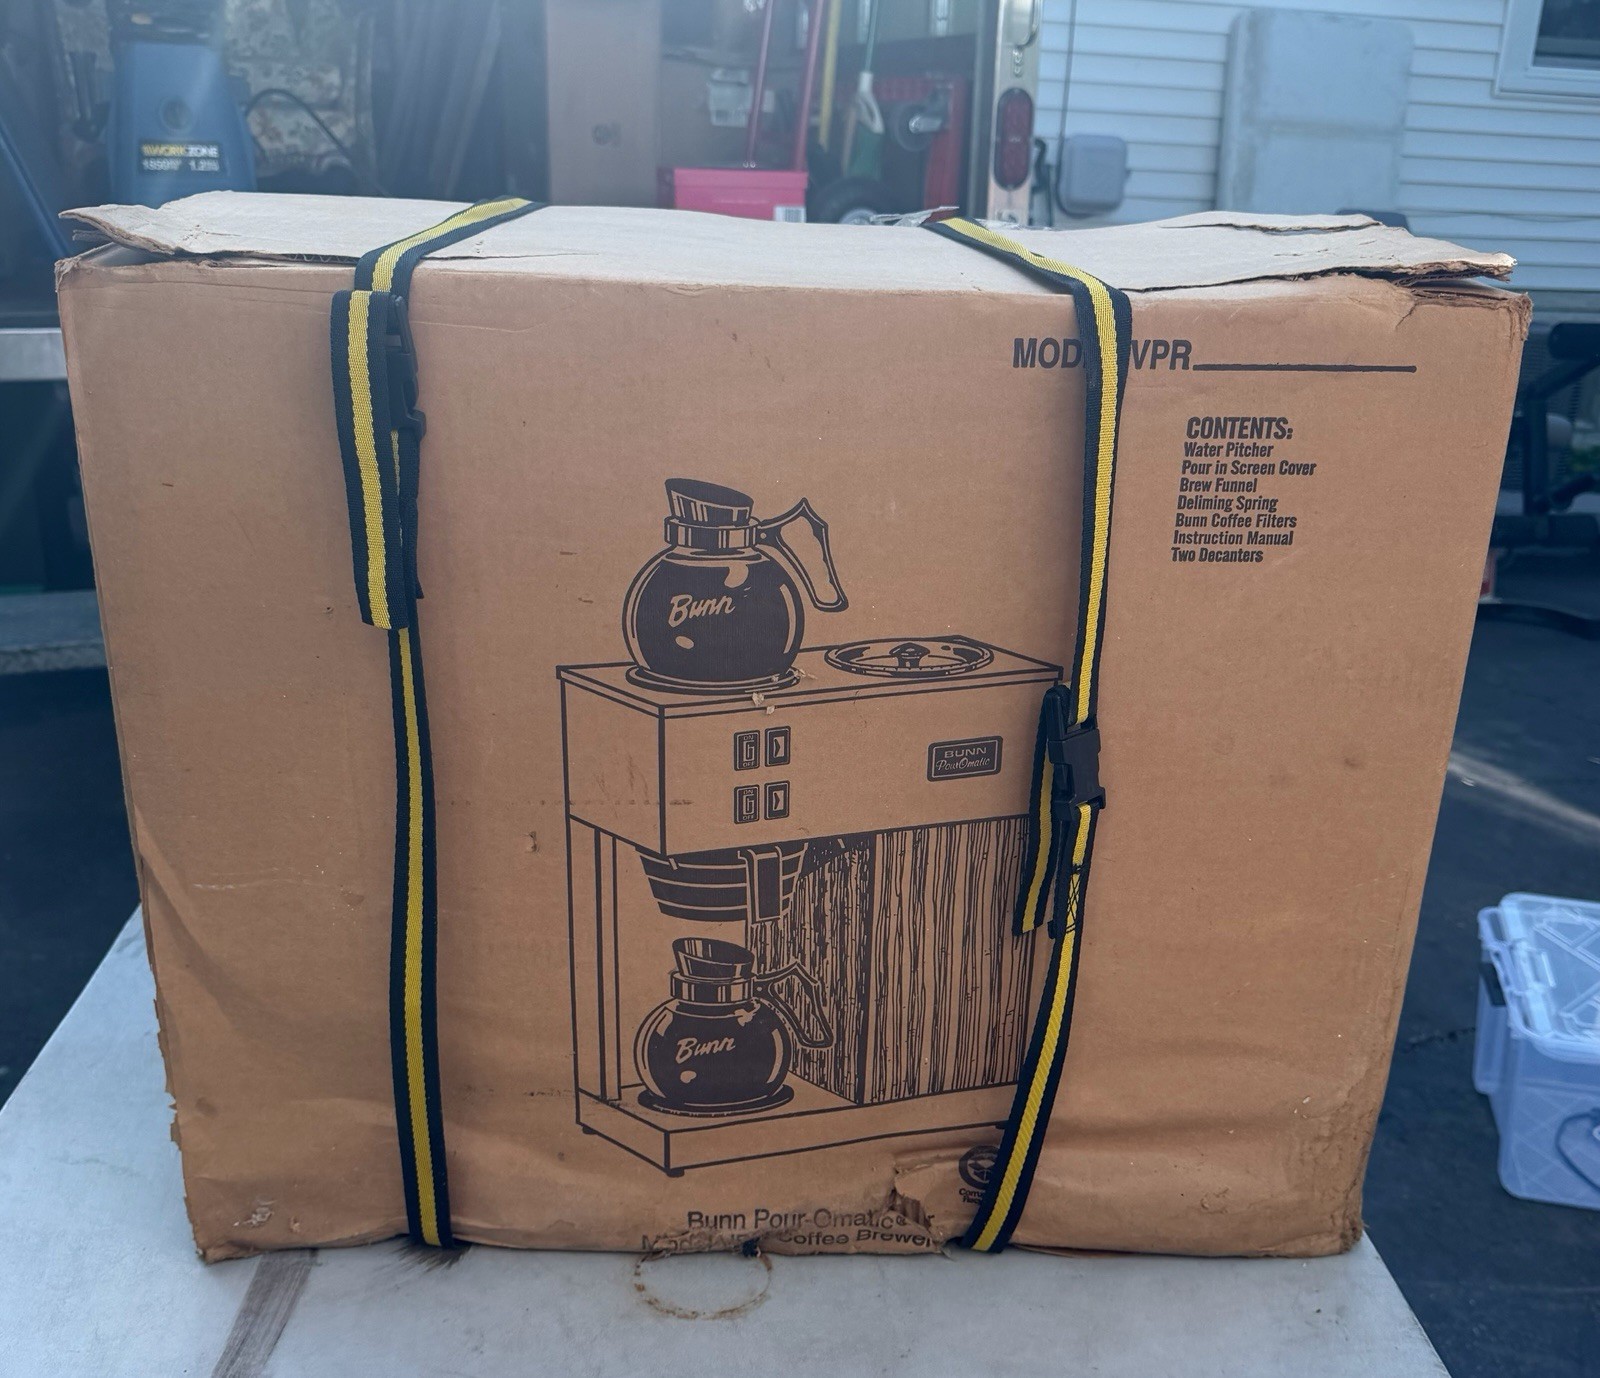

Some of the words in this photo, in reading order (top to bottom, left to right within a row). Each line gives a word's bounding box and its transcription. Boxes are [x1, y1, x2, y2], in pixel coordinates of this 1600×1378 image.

[1012, 337, 1084, 368] MOD
[1131, 339, 1192, 370] VPR
[1186, 416, 1294, 440] CONTENTS:
[1184, 442, 1223, 457] Water
[1225, 442, 1274, 457] Pitcher
[1182, 460, 1212, 475] Pour
[1215, 460, 1227, 475] in
[1231, 460, 1275, 475] Screen
[1279, 460, 1317, 476] Cover
[1180, 477, 1212, 492] Brew
[1215, 478, 1258, 493] Funnel
[1177, 495, 1234, 512] Deliming
[1236, 495, 1279, 513] Spring
[1175, 513, 1207, 527] Bunn
[1211, 513, 1252, 528] Coffee
[1256, 514, 1297, 528] Filters
[1173, 530, 1243, 545] Instruction
[1247, 531, 1294, 545] Manual
[1171, 547, 1196, 562] Two
[1198, 548, 1264, 563] Decanters
[668, 594, 735, 628] Bunn
[944, 747, 987, 759] BUNN
[675, 1037, 736, 1064] Bunn
[687, 1211, 746, 1230] Bunn
